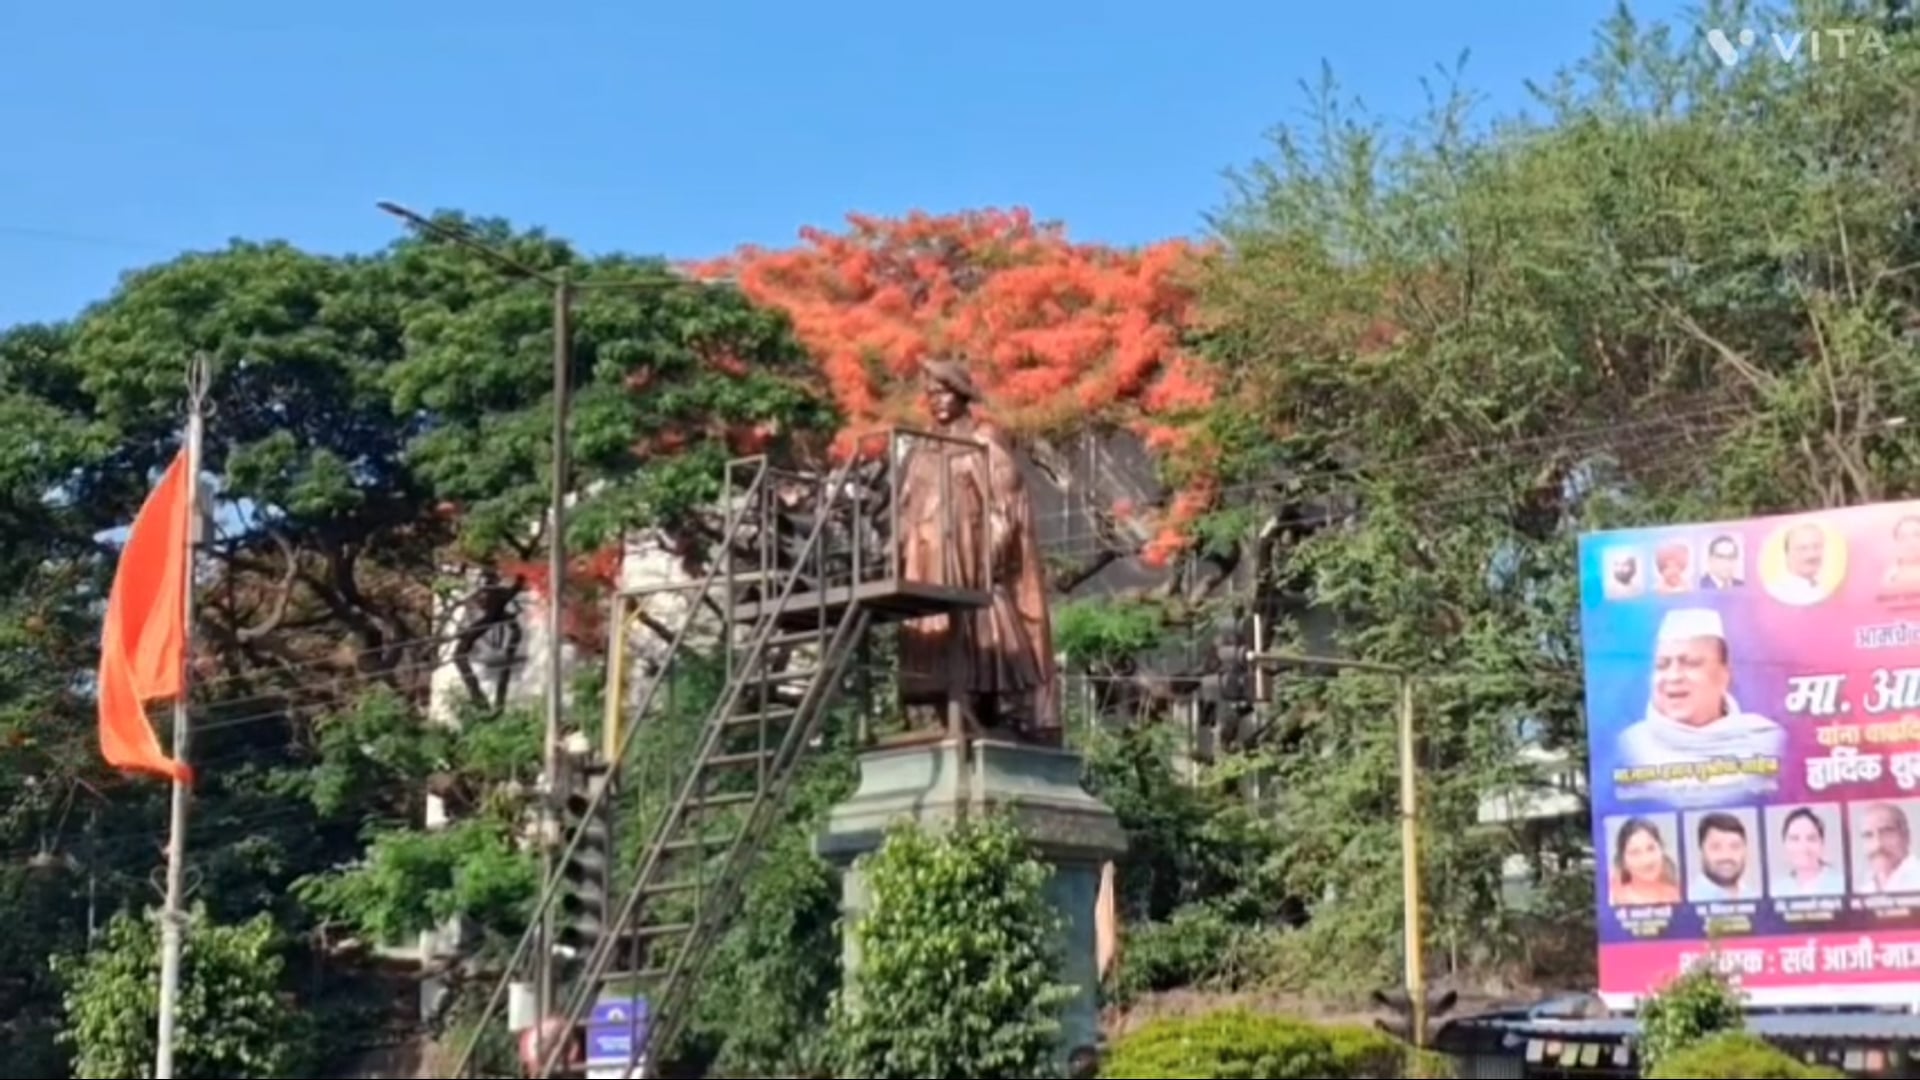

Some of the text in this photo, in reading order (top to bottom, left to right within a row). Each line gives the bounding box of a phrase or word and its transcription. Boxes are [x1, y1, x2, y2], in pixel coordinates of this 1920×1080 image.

[1785, 674, 1852, 716] मा.
[1805, 747, 1882, 790] हार्दिक
[1780, 939, 1816, 974] सर्व
